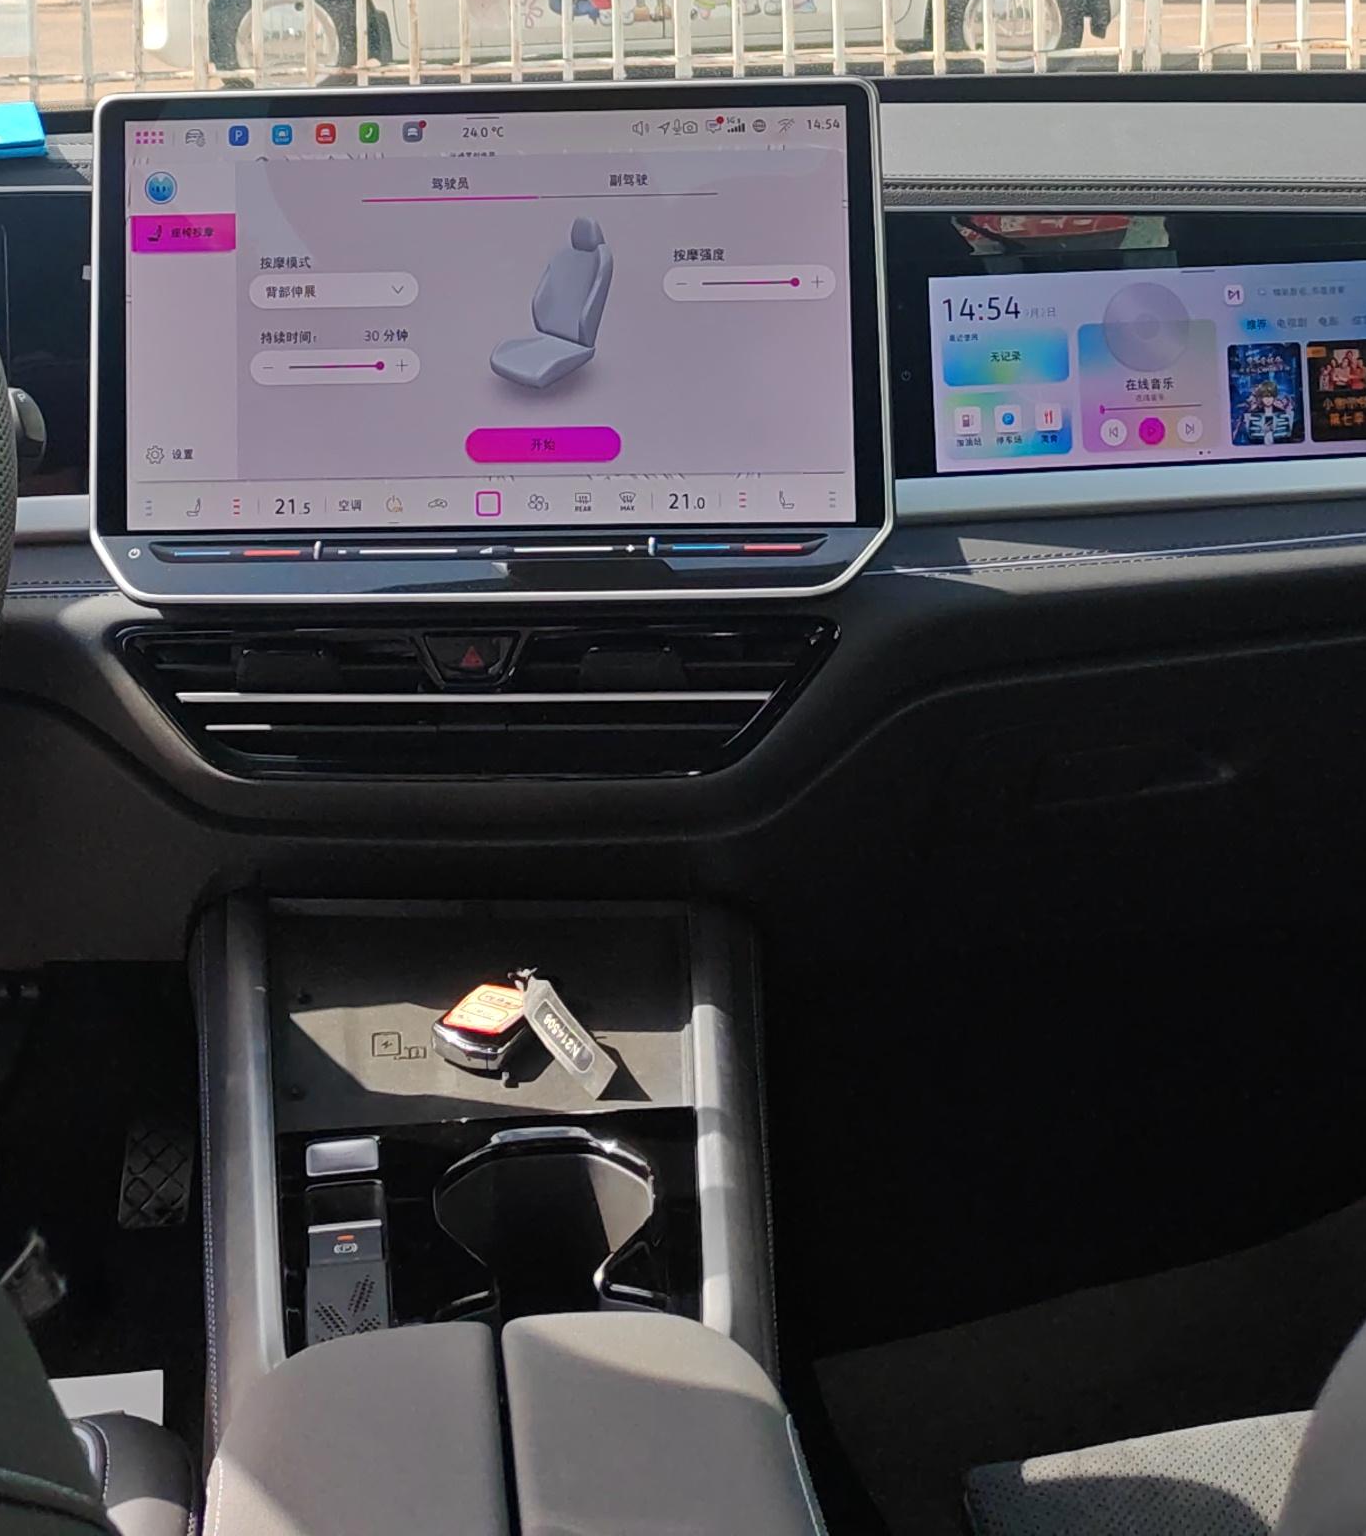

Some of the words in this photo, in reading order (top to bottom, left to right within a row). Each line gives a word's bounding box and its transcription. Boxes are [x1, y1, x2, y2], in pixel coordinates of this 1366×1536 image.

[432, 176, 469, 190] 驾驶员
[609, 173, 648, 187] 副驾驶
[673, 248, 725, 262] 按摩强度
[259, 256, 312, 270] 按摩模式
[265, 285, 316, 299] 背部伸展
[942, 295, 1021, 322] 14:54
[364, 330, 380, 342] 30
[383, 328, 409, 342] 分钟
[990, 351, 1021, 362] 无记录
[1125, 378, 1174, 391] 在线音乐
[530, 438, 555, 452] 开始
[996, 435, 1023, 445] 停车场
[172, 448, 194, 461] 设置
[338, 499, 362, 512] 空调
[574, 504, 592, 512] REAR
[668, 493, 706, 510] 21.0
